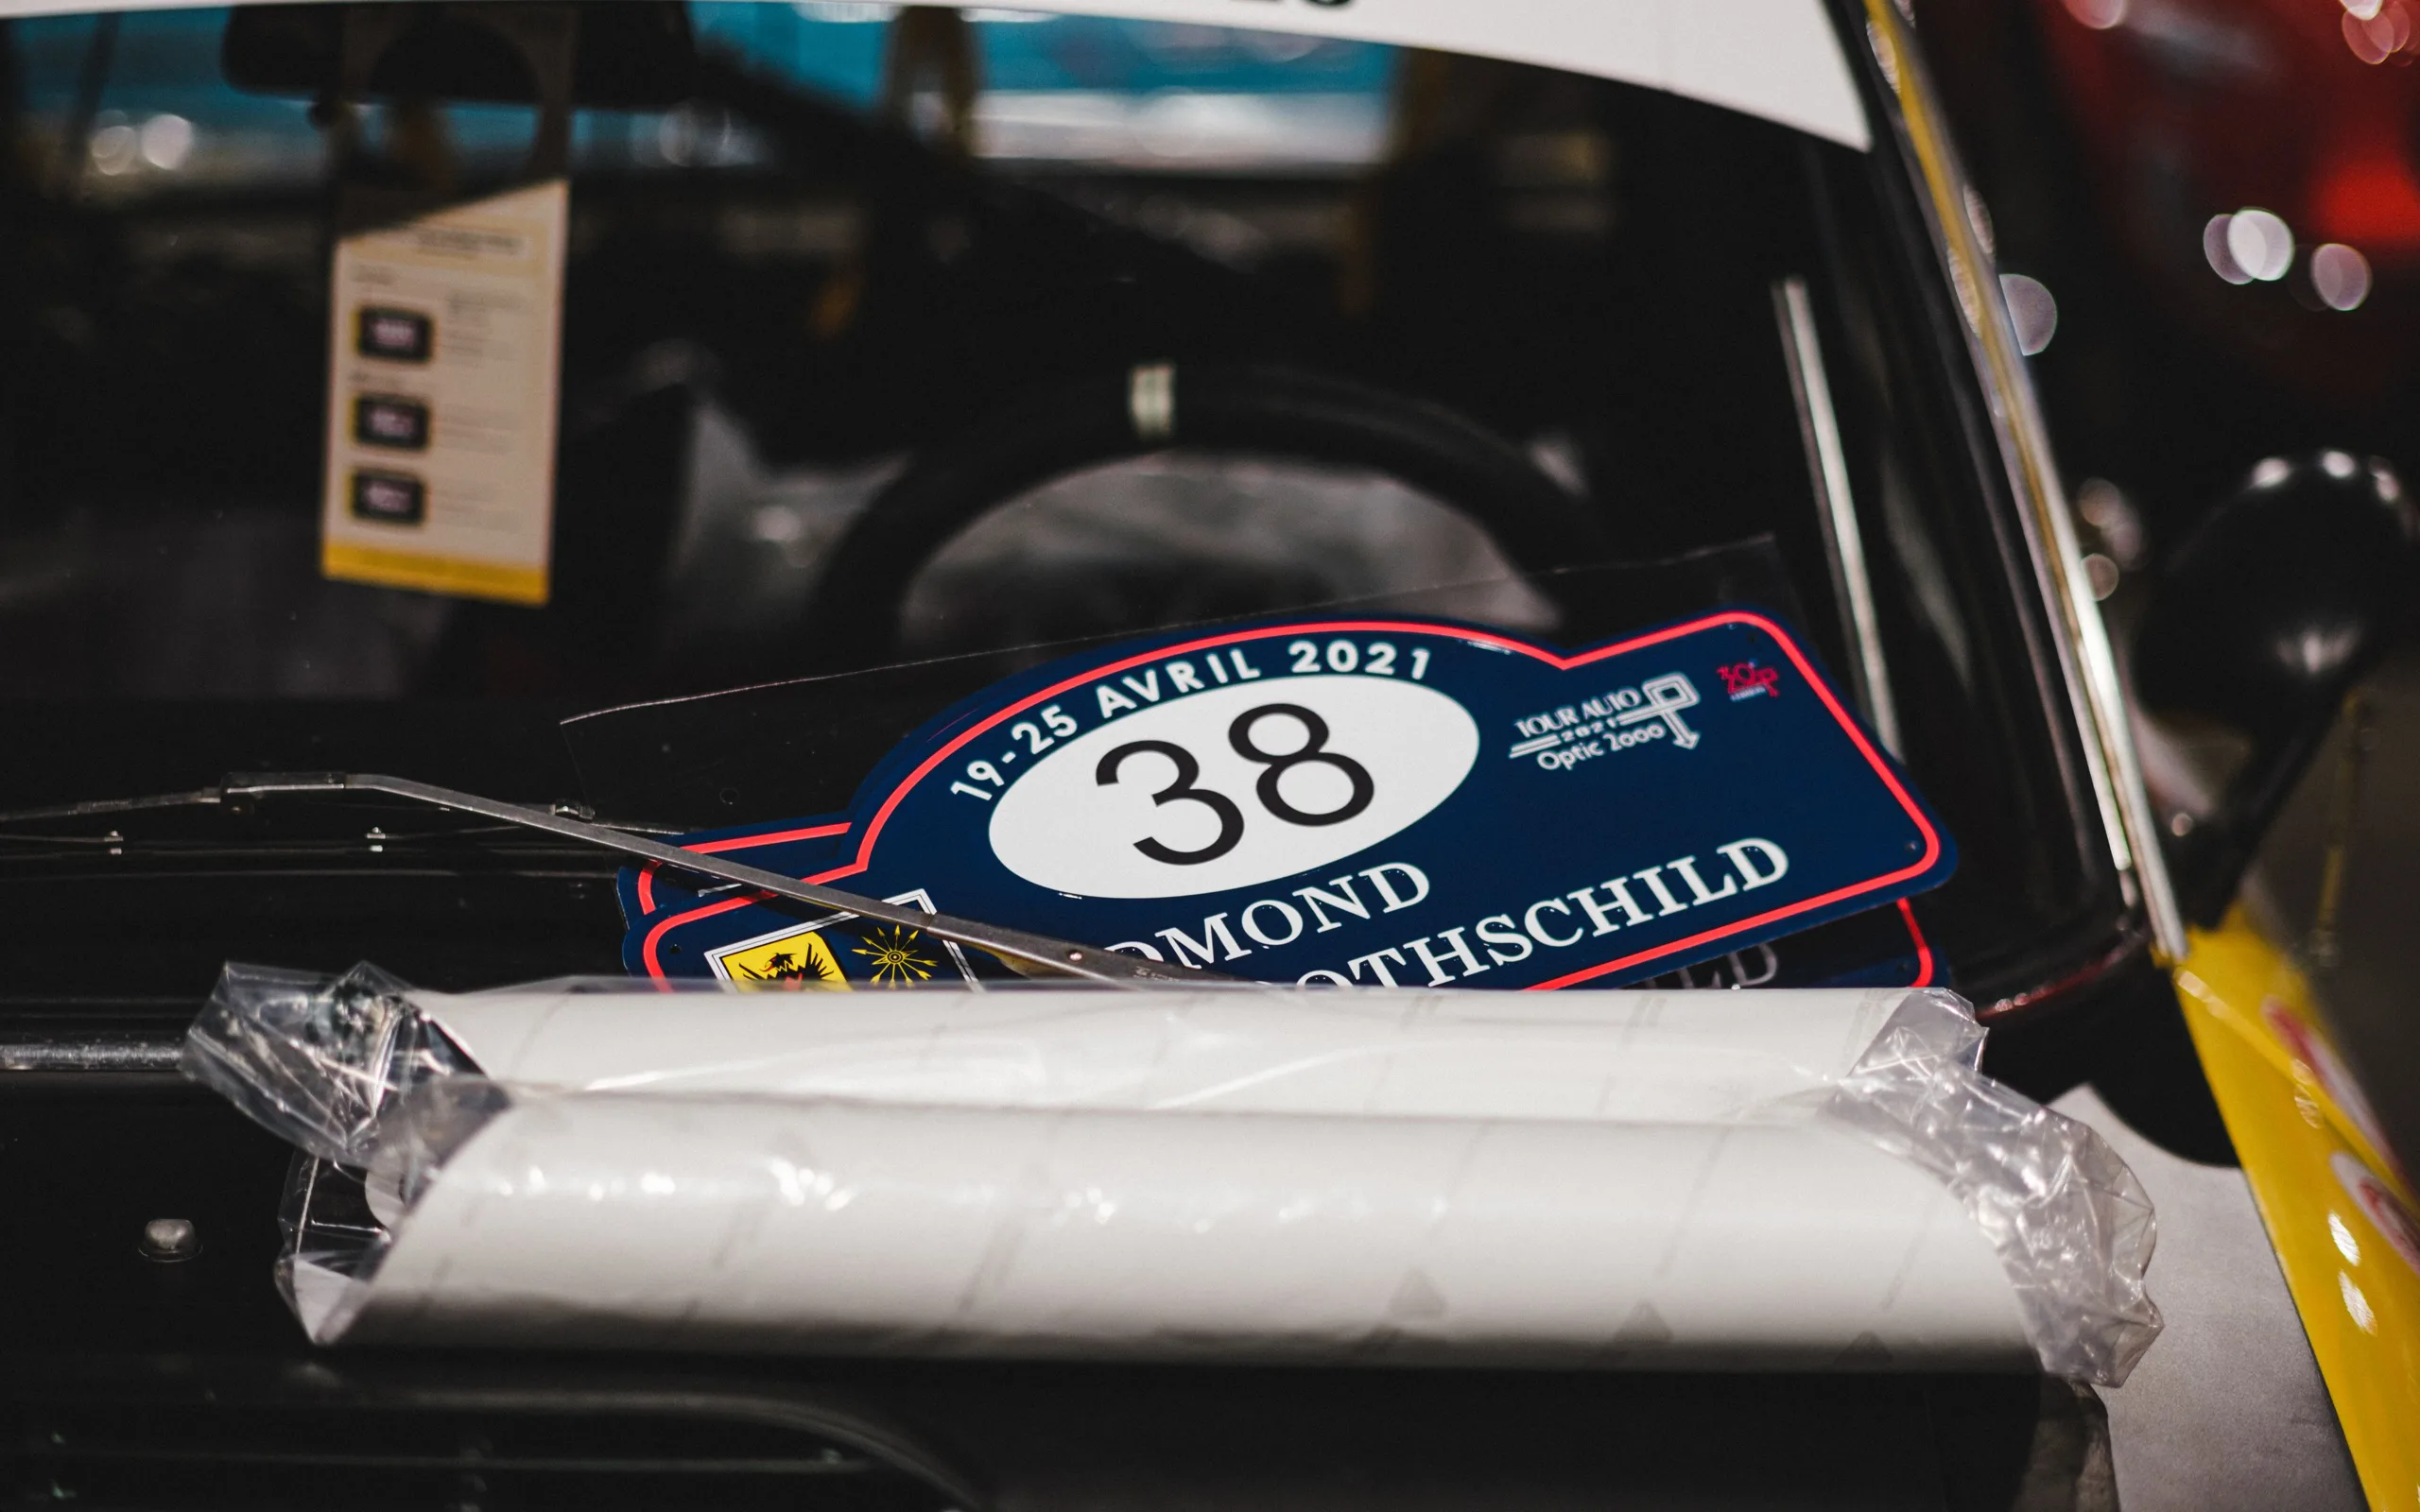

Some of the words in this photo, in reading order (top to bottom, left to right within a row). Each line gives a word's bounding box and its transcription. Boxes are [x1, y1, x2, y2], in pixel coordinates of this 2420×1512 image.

[949, 703, 1078, 802] 19-25
[1095, 648, 1261, 719] AVRIL
[1288, 639, 1432, 679] 2021
[1513, 704, 1581, 739] TOUR
[1581, 687, 1642, 721] AUTO
[1561, 716, 1617, 743] 2021
[1536, 741, 1605, 771] Optic
[1602, 722, 1668, 752] 2000
[1095, 702, 1375, 867] 38
